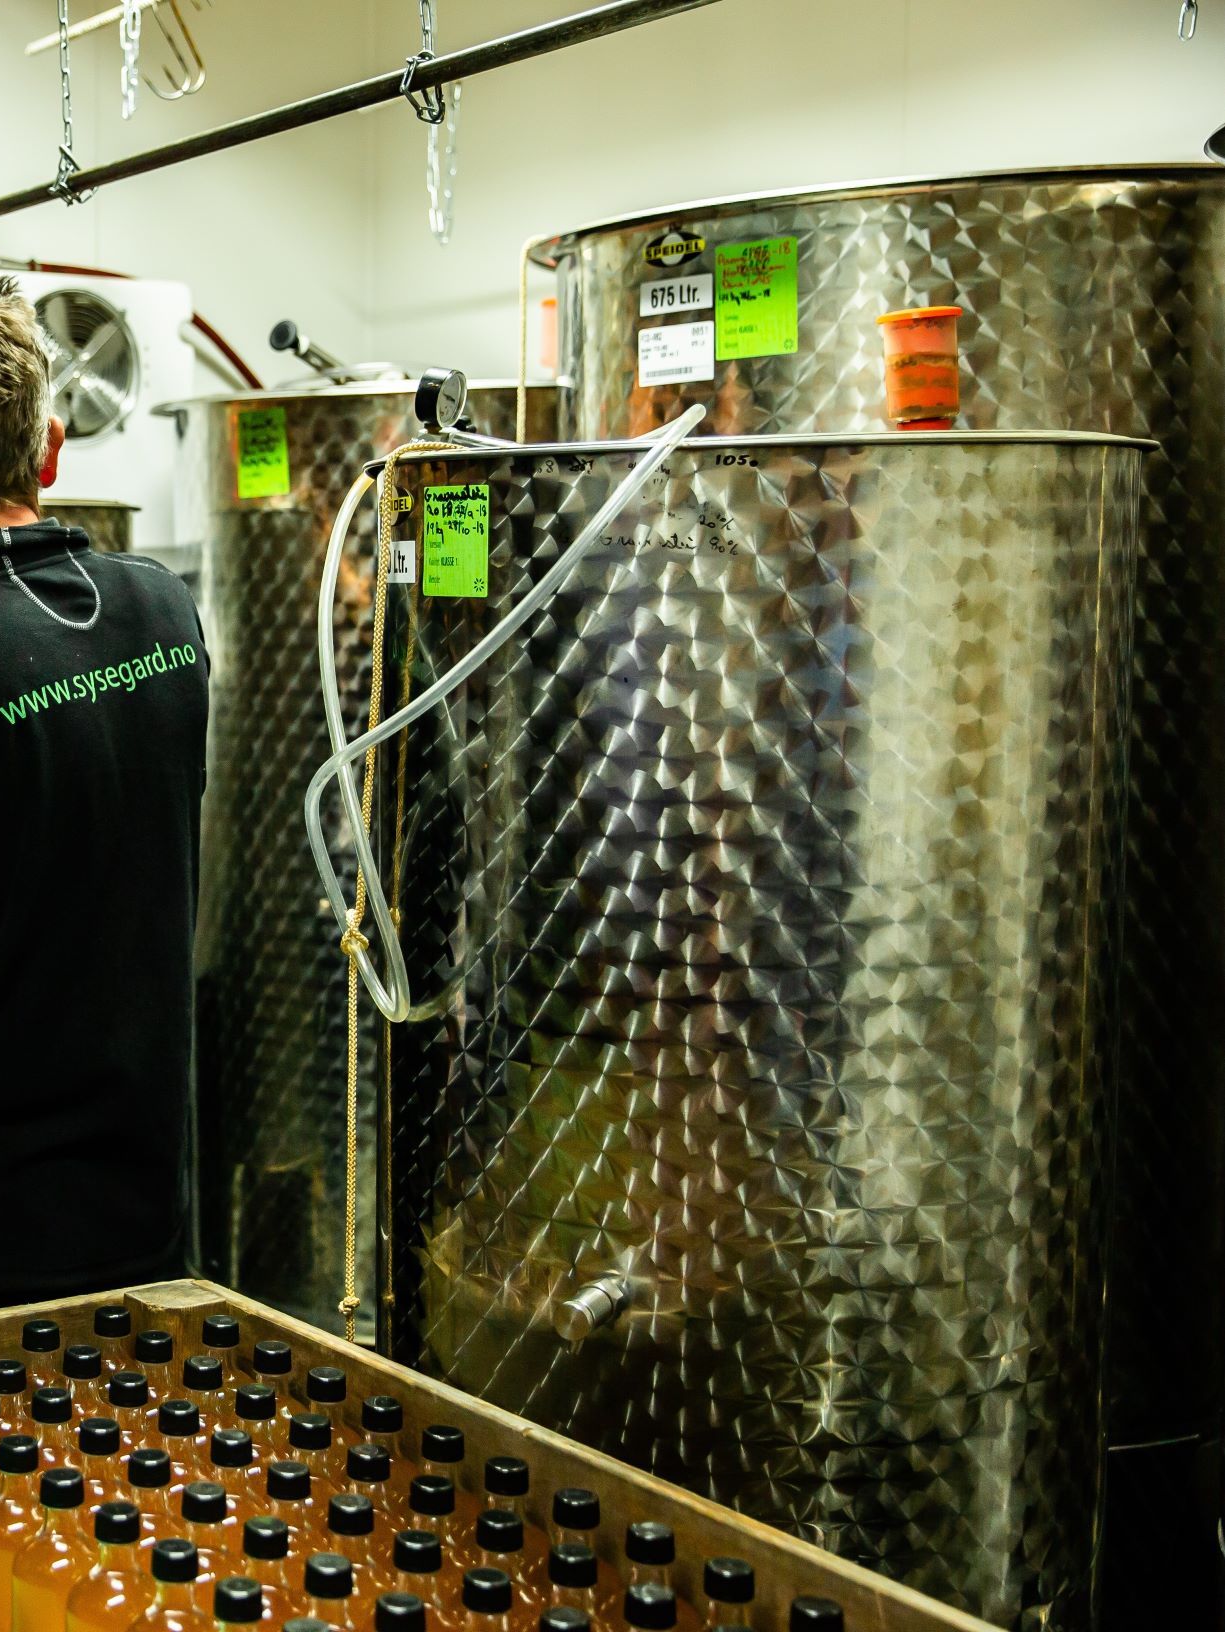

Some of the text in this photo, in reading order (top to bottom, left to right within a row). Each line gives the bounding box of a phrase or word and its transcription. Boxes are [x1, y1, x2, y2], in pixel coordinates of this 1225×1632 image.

[645, 240, 700, 259] SPEIDEL
[651, 285, 675, 309] 675
[679, 284, 700, 305] Ltr.
